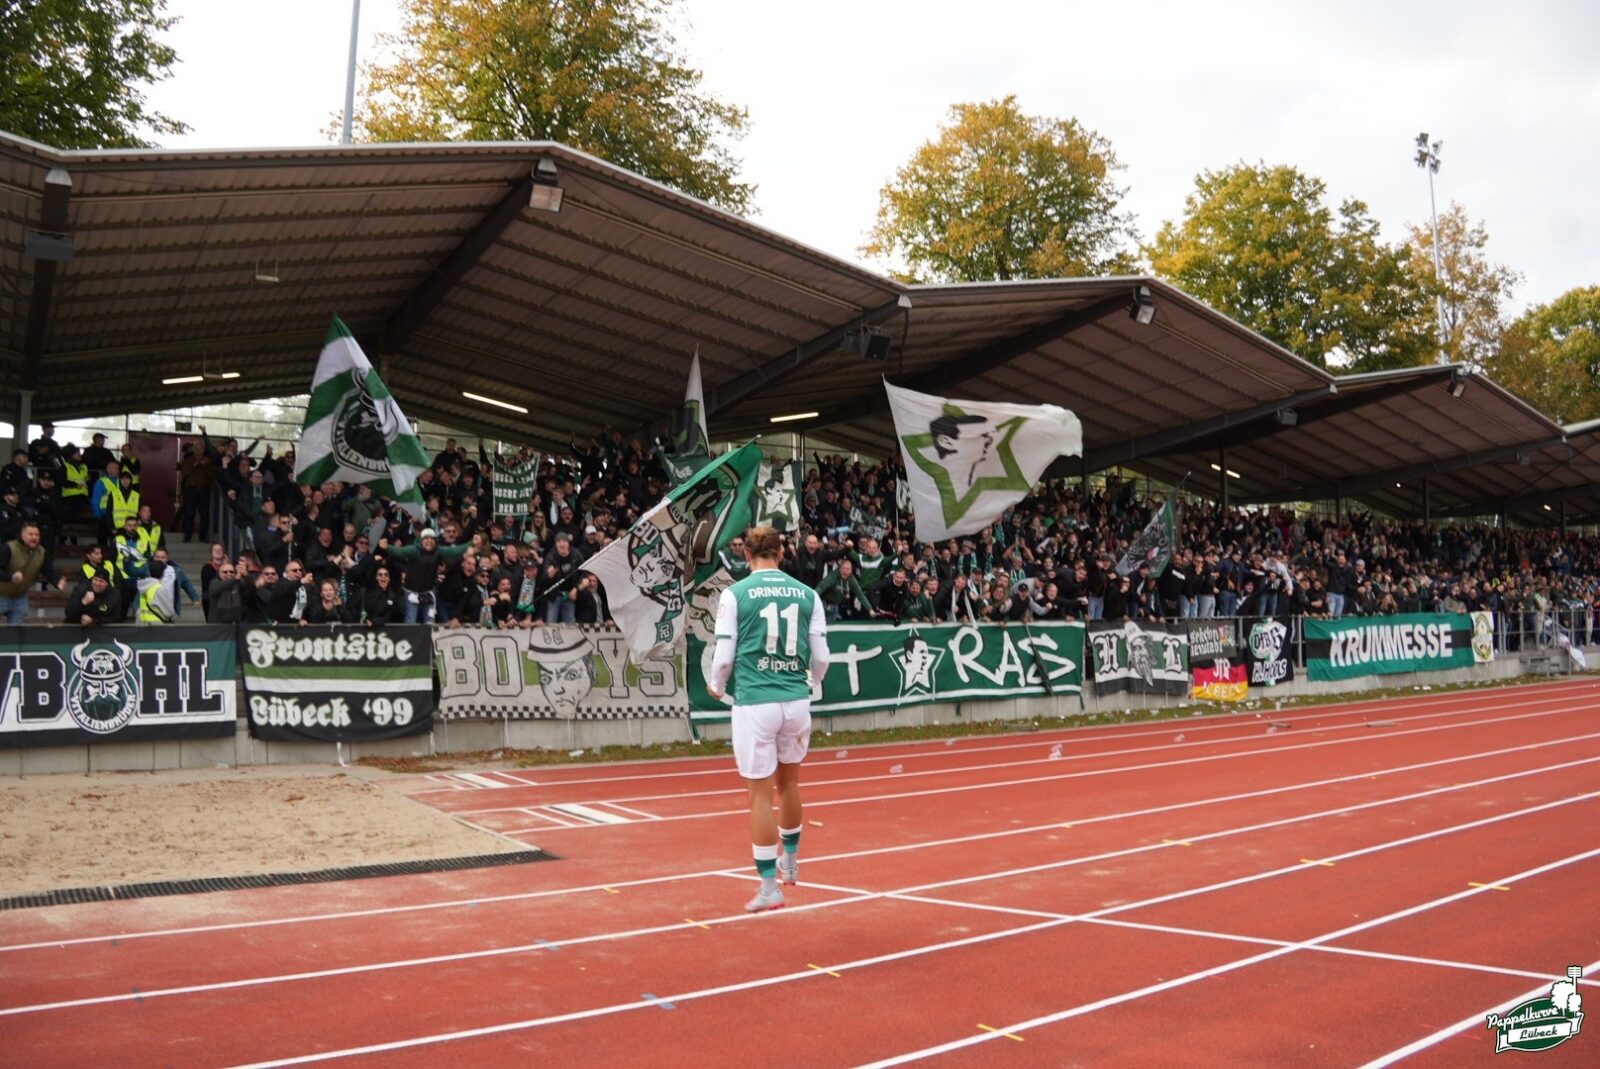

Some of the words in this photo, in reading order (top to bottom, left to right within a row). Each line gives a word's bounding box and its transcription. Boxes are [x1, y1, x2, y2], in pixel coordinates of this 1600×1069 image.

[748, 586, 806, 600] DRINKUTH
[246, 629, 413, 668] Frontside
[760, 602, 799, 656] 11
[1329, 623, 1453, 668] KRUMMESSE
[136, 648, 225, 718] HL
[250, 695, 352, 727] Lübeck
